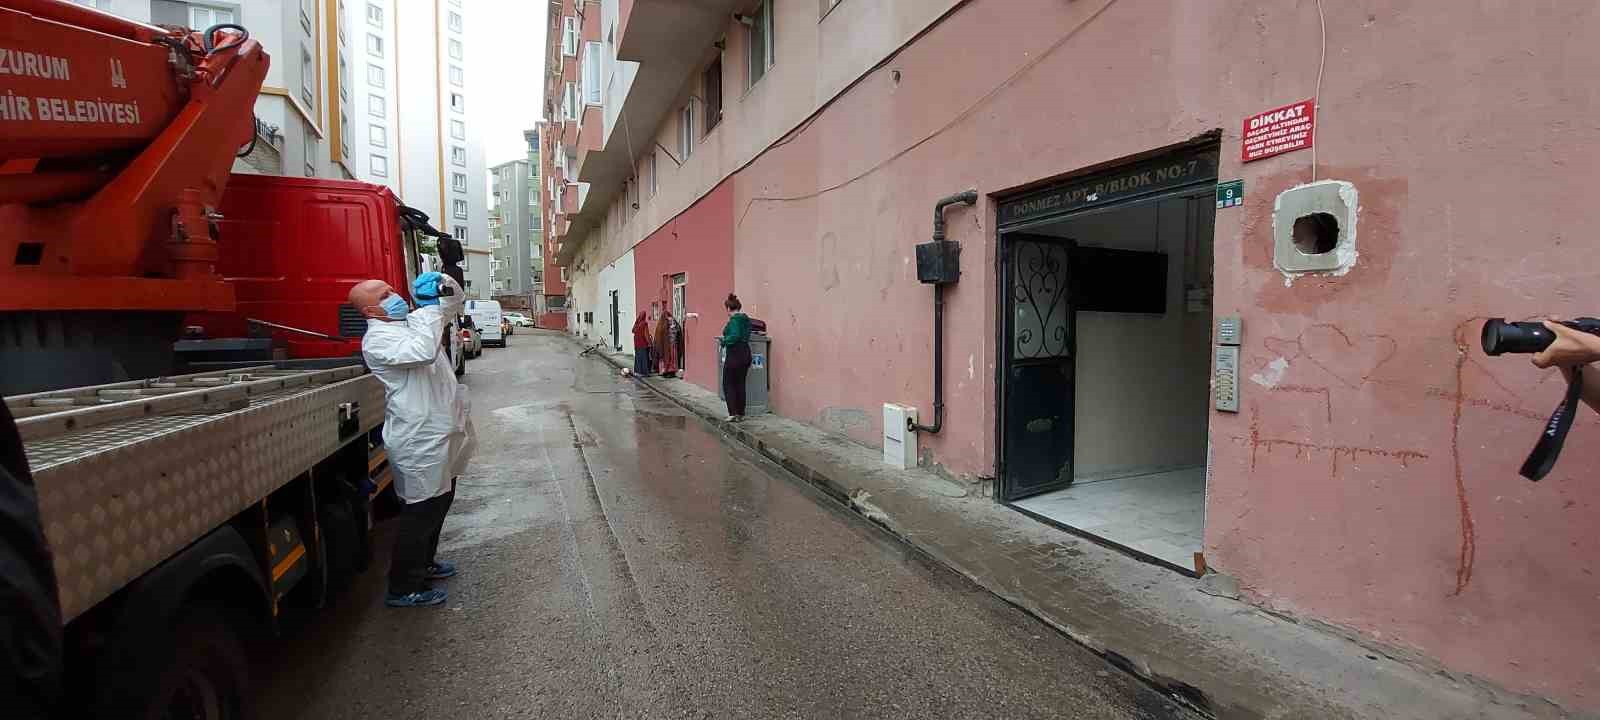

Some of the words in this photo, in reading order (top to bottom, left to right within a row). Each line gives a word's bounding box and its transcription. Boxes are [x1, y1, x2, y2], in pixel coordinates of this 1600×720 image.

[36, 97, 140, 124] BELEDİYESİ
[1251, 105, 1305, 129] DİKKAT
[1156, 160, 1197, 181] NO:7
[1226, 189, 1233, 199] 9
